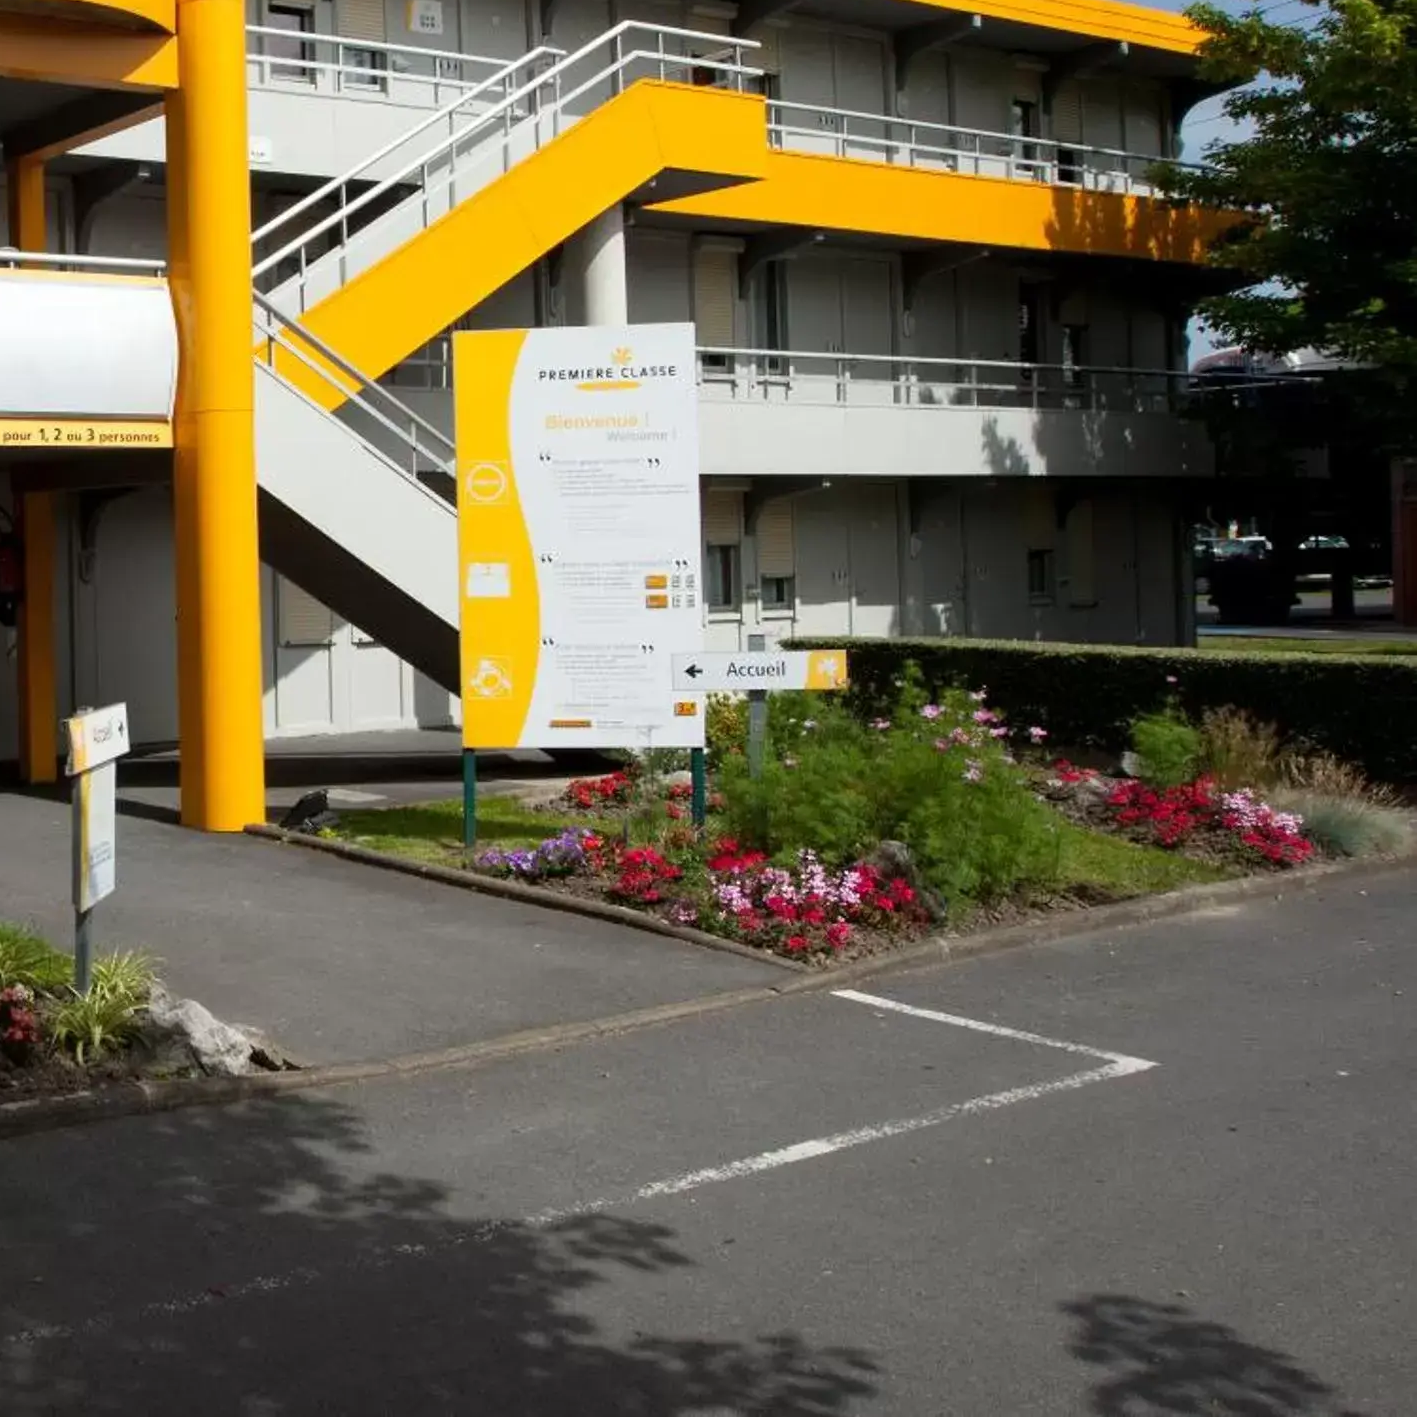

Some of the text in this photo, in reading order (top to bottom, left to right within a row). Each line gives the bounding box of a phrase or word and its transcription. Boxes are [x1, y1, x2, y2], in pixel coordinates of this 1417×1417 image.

[538, 365, 678, 381] PREMIERE CLASSE
[2, 430, 32, 445] pour
[53, 428, 63, 441] 2
[66, 432, 82, 442] ou
[86, 428, 95, 442] 3
[98, 432, 160, 446] personnes
[726, 661, 786, 678] Accueil
